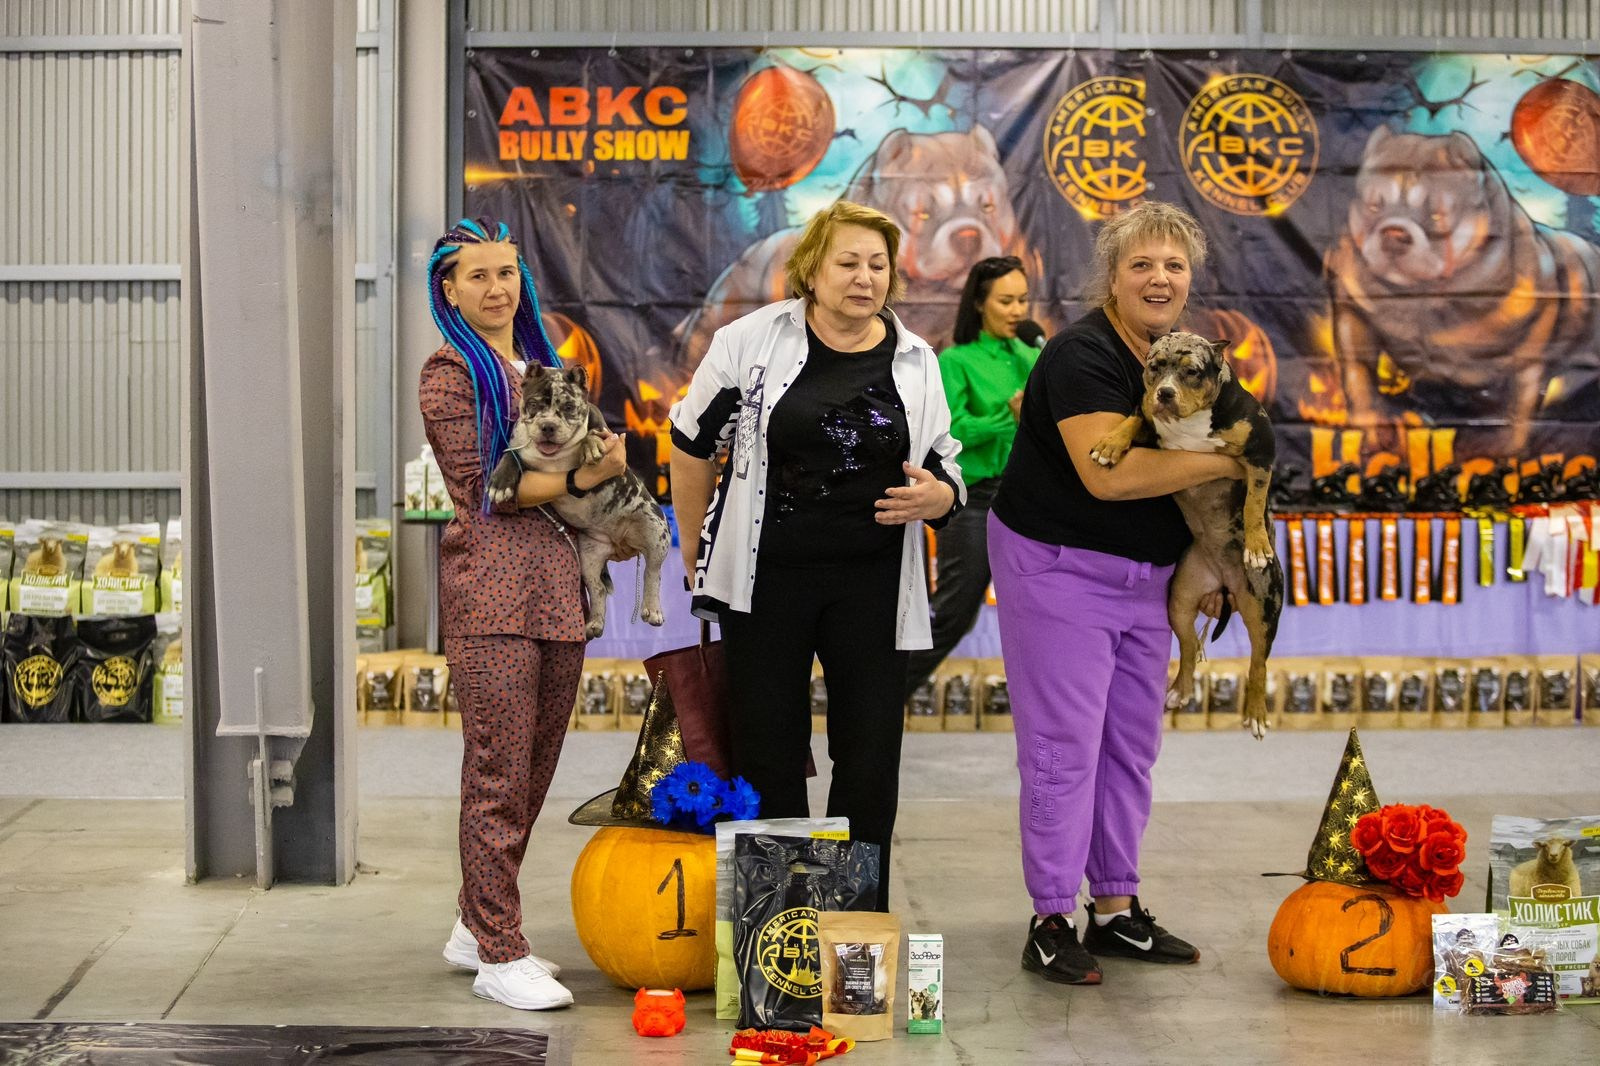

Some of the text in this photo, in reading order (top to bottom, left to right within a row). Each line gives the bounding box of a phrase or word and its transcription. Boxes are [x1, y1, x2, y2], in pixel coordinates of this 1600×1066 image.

[499, 86, 689, 126] ABKC
[1052, 82, 1132, 136] AMERICAN
[1186, 79, 1312, 132] AMERICAN BULLY
[499, 131, 691, 161] BULLY SHOW
[1186, 131, 1305, 166] ABKC
[1193, 169, 1307, 213] KENNEL CLUB
[96, 577, 141, 590] ХОЛИСТИК
[657, 858, 698, 940] 1
[1514, 900, 1594, 923] ХОЛИСТИК
[763, 910, 817, 943] AMERICAN
[1340, 893, 1397, 976] 2
[1555, 951, 1577, 962] ПОРОД
[1570, 939, 1591, 950] СОБАК
[764, 965, 806, 996] KENNEL
